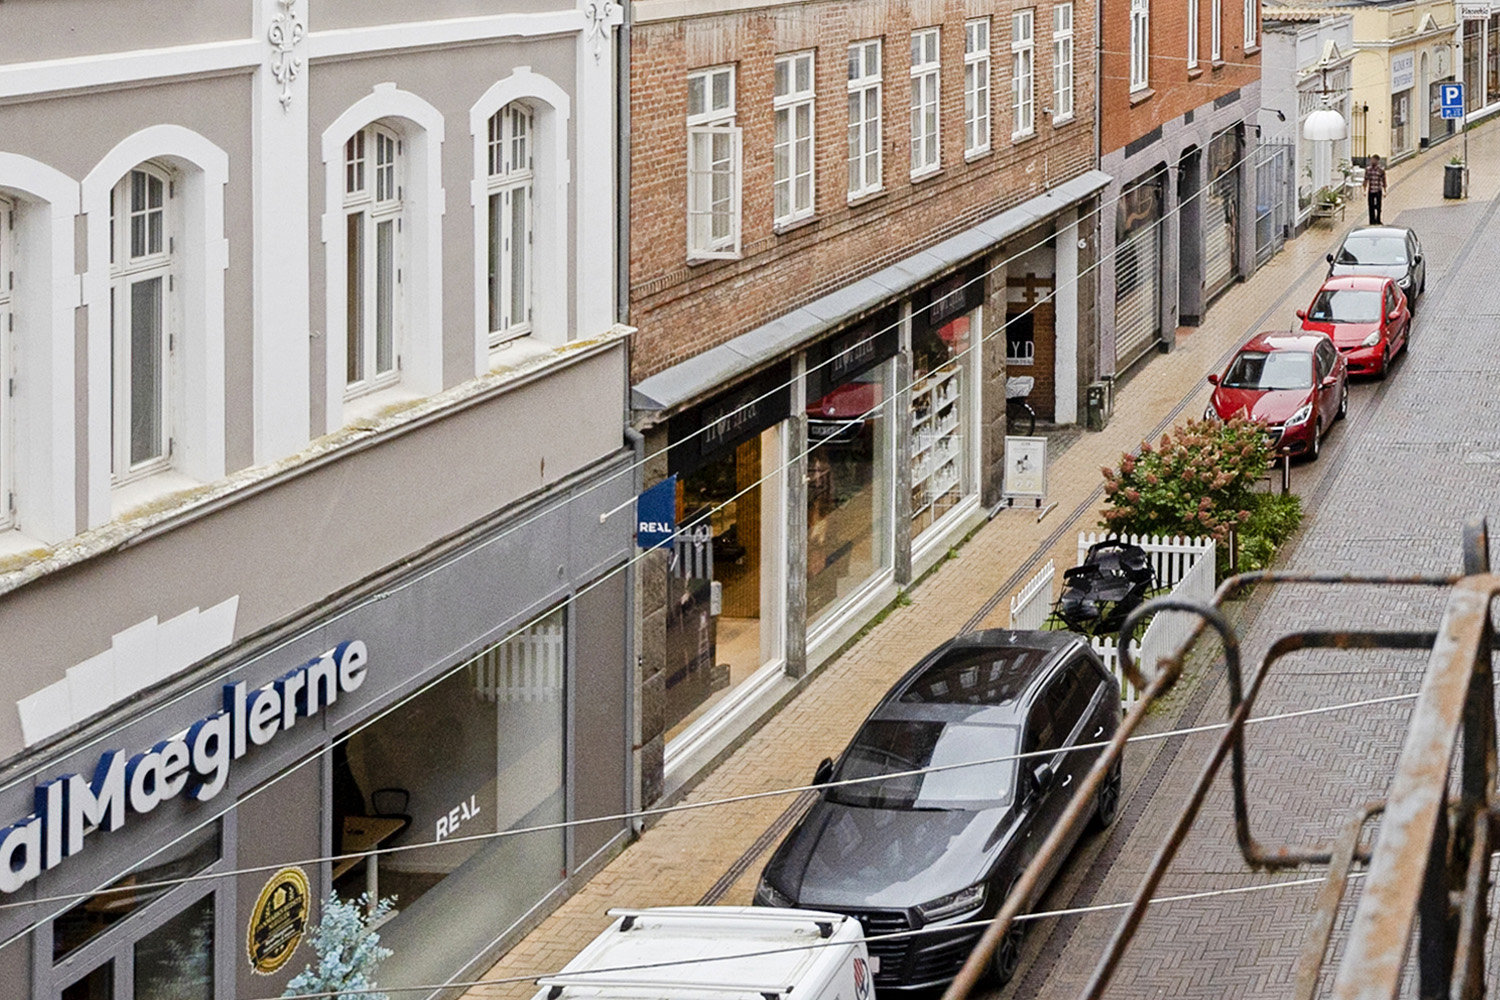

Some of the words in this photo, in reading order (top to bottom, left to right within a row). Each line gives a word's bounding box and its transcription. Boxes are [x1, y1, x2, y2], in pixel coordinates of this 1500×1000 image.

[1445, 86, 1459, 105] P
[1077, 237, 1087, 249] 6
[639, 521, 672, 533] REAL
[436, 794, 481, 842] REAL
